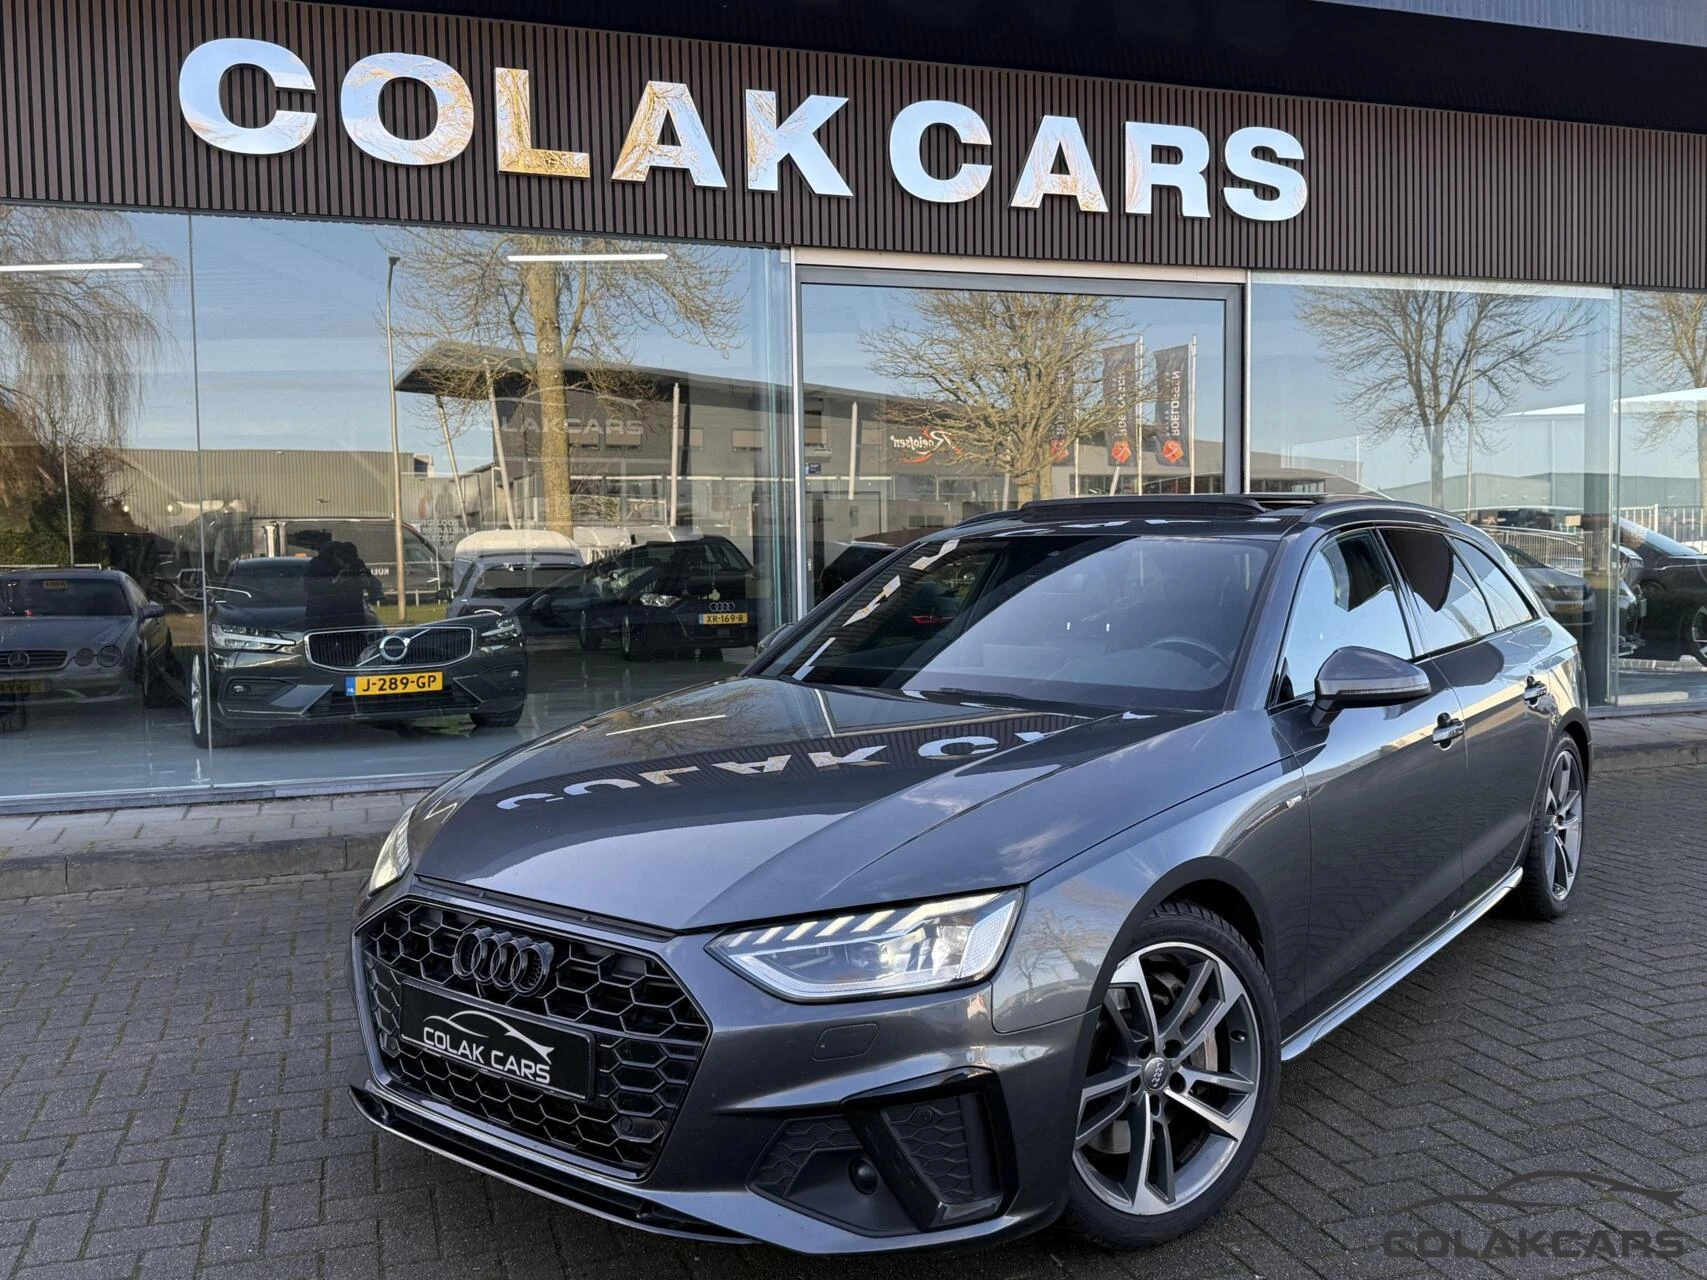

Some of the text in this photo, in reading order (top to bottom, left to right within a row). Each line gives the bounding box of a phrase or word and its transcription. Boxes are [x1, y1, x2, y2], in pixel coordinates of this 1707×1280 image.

[179, 38, 1309, 222] COLAK CARS
[706, 614, 744, 623] XR-169-R
[361, 675, 437, 692] J-289-GP
[423, 1026, 550, 1084] COLAK CARS
